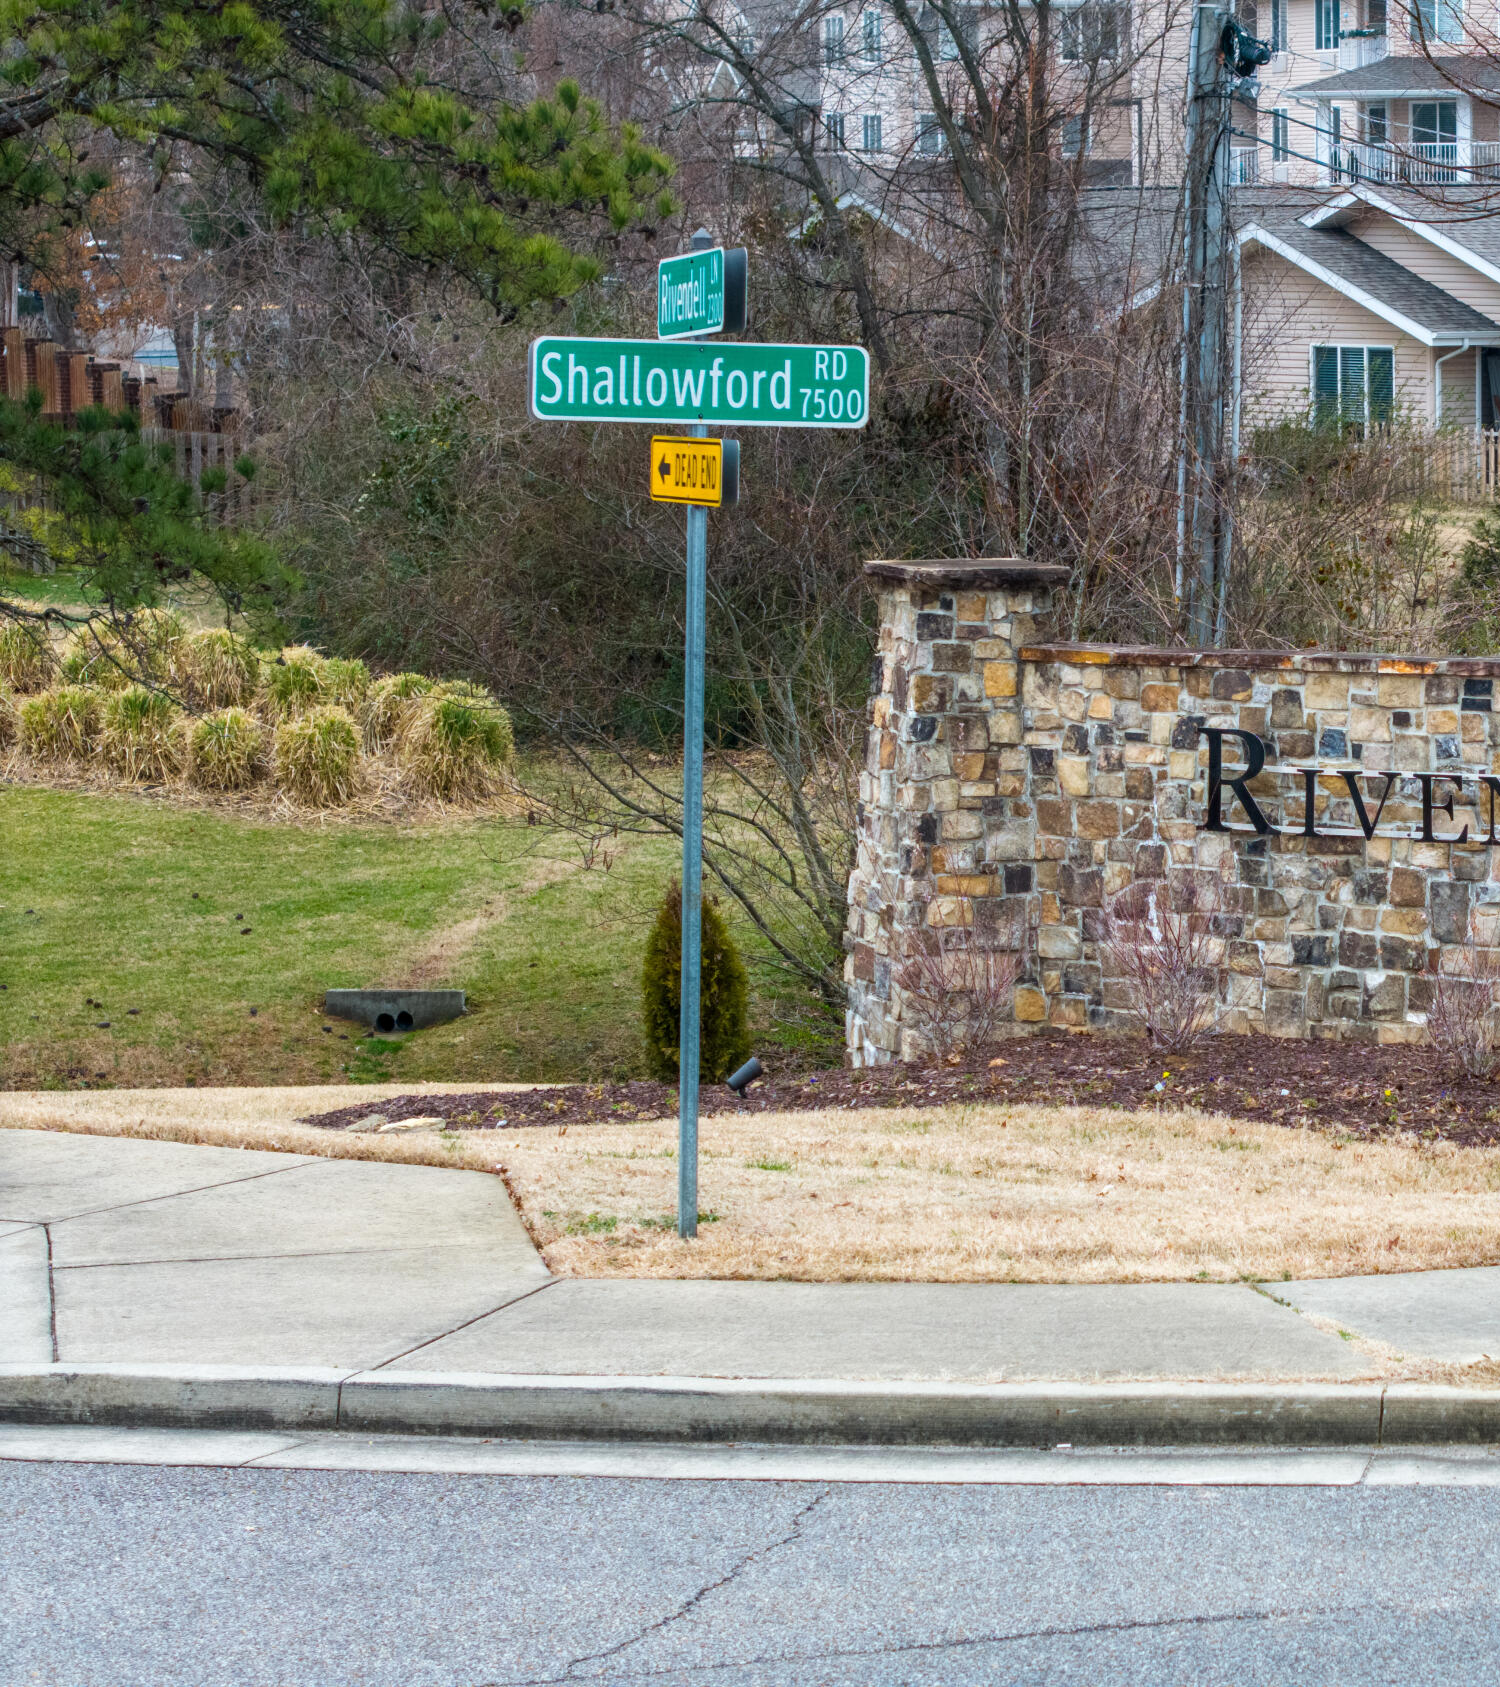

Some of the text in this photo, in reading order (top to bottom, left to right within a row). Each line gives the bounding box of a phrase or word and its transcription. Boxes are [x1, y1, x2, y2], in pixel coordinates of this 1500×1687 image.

[661, 252, 719, 324] Rivendell LN
[541, 350, 847, 410] Shallowford RD
[799, 388, 862, 420] 7500
[675, 453, 717, 489] DEAD END
